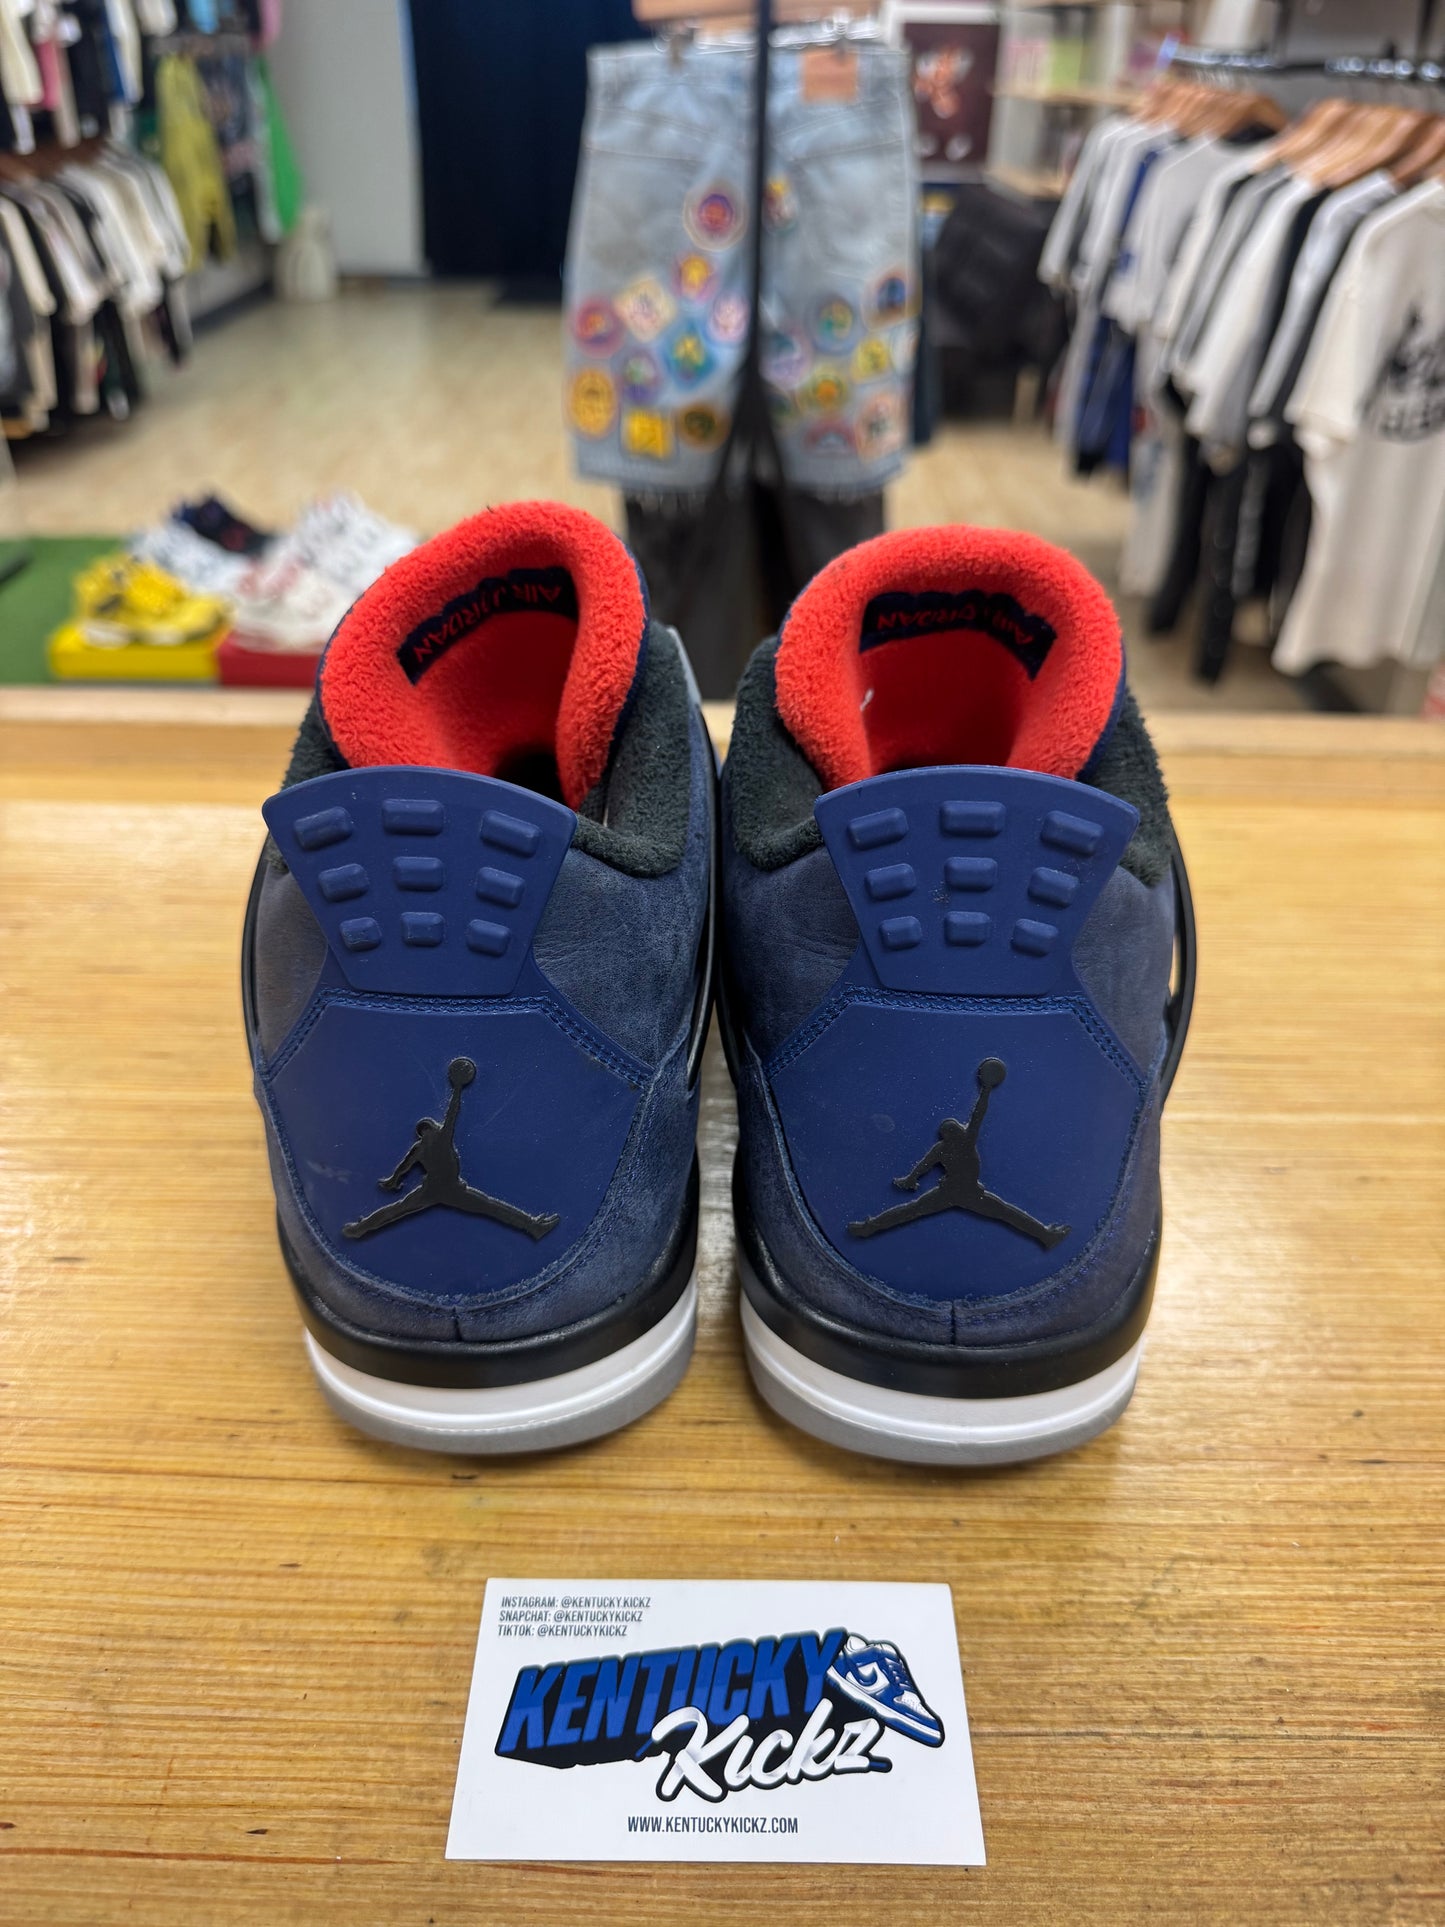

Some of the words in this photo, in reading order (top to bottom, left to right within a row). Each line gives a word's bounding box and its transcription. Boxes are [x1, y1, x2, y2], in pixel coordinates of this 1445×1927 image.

[511, 583, 562, 603] AIR
[876, 603, 990, 631] ORDAN
[501, 1596, 559, 1608] INSTAGRAM:
[499, 1610, 552, 1622] SNAPCHAT:
[553, 1610, 643, 1623] @KENTUCKYKICKZ
[498, 1624, 535, 1637] TIKTOK:
[537, 1624, 628, 1637] @KENTUCKYKICKZ
[498, 1629, 848, 1755] KENTUCKY
[627, 1816, 799, 1834] WWW.KENTUCKYKICKZ.COM
